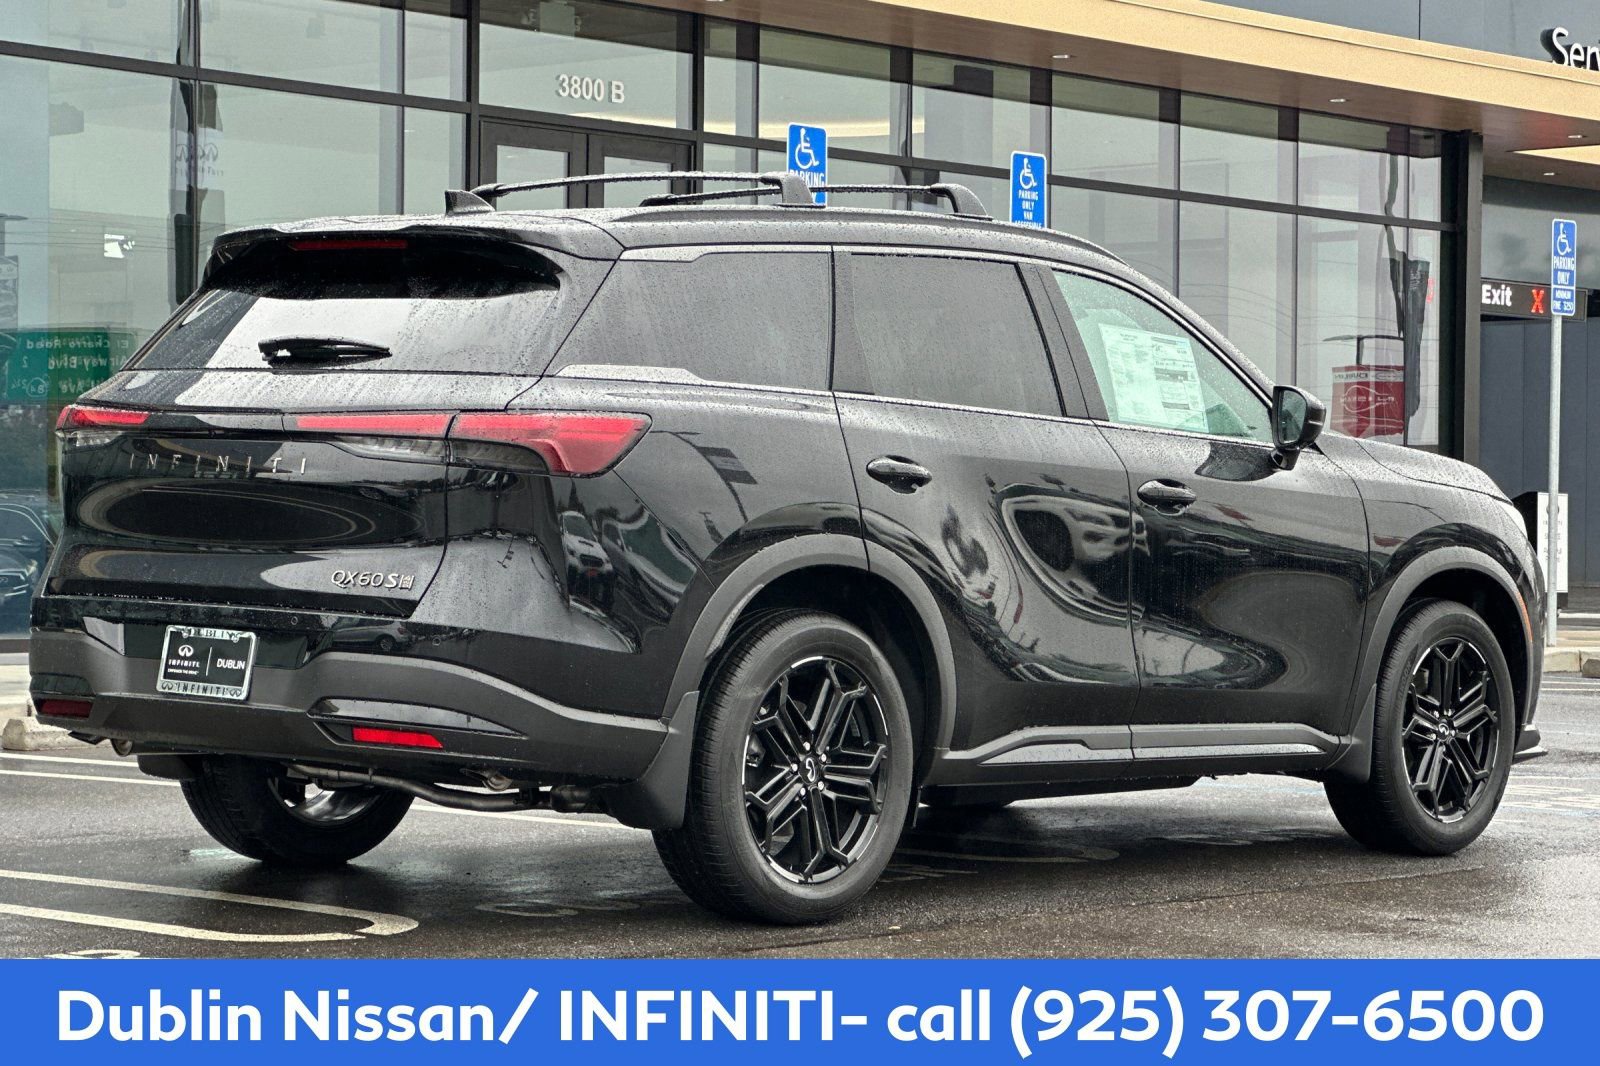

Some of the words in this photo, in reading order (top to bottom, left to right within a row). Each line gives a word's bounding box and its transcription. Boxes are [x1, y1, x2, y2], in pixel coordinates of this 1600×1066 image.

[558, 73, 605, 102] 3800
[611, 79, 625, 104] B
[1018, 189, 1039, 201] PARKING
[1022, 200, 1035, 210] ONLY
[1553, 255, 1575, 270] PARKING
[1557, 271, 1570, 285] ONLY
[1481, 284, 1512, 307] Exit
[129, 452, 307, 475] INFINITI
[216, 658, 246, 670] DUBLIN
[175, 682, 228, 696] INFINITI
